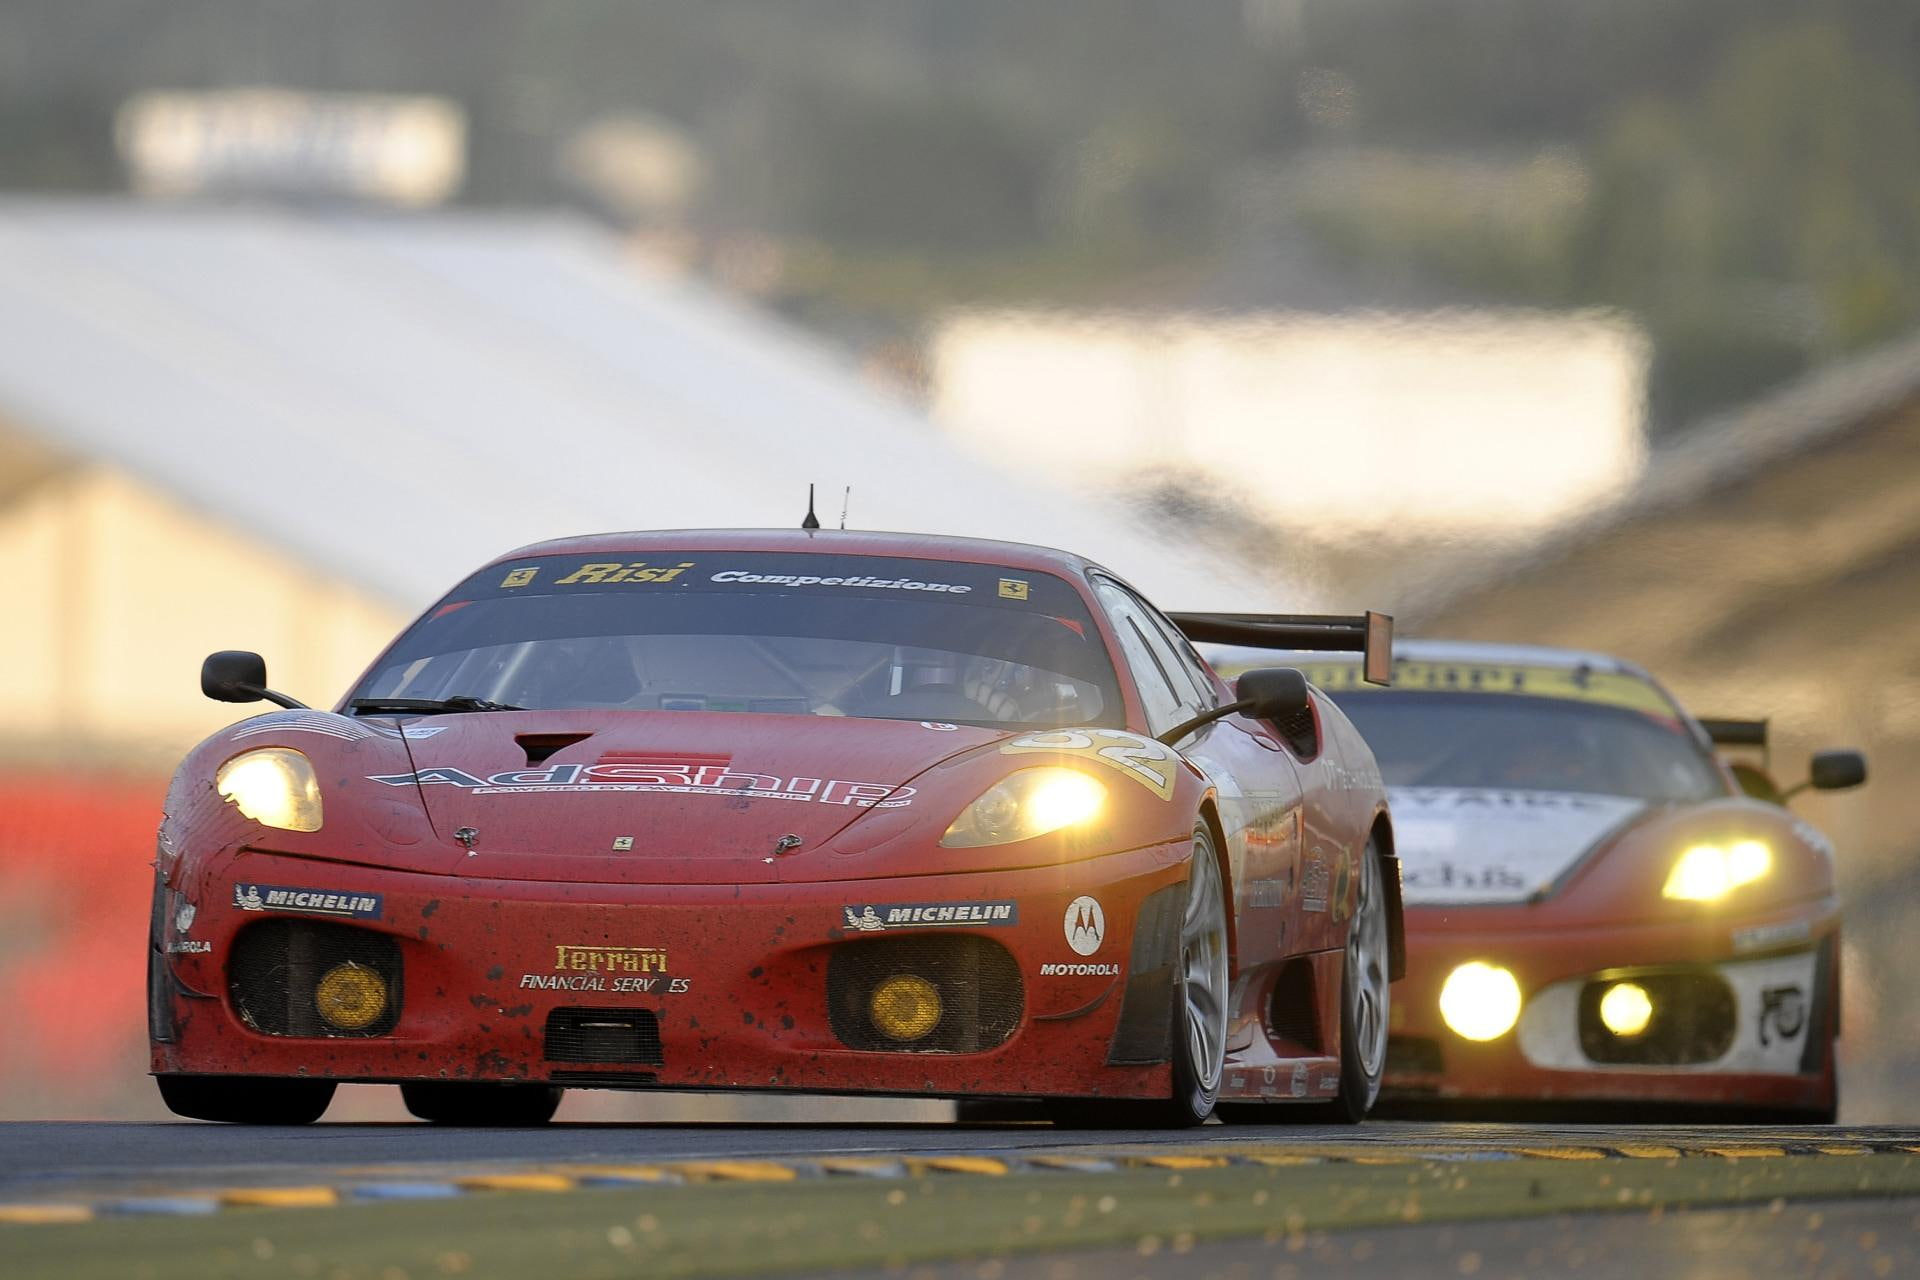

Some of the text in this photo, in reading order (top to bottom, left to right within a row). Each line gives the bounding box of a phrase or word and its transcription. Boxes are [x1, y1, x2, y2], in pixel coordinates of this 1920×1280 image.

[554, 561, 973, 595] Risi Competizione
[265, 889, 377, 913] MICHELIN
[887, 904, 1012, 923] MICHELIN
[555, 945, 667, 973] Ferrari
[1039, 962, 1120, 976] MOTOROLA
[519, 973, 691, 993] FINANCIAL SERVES
